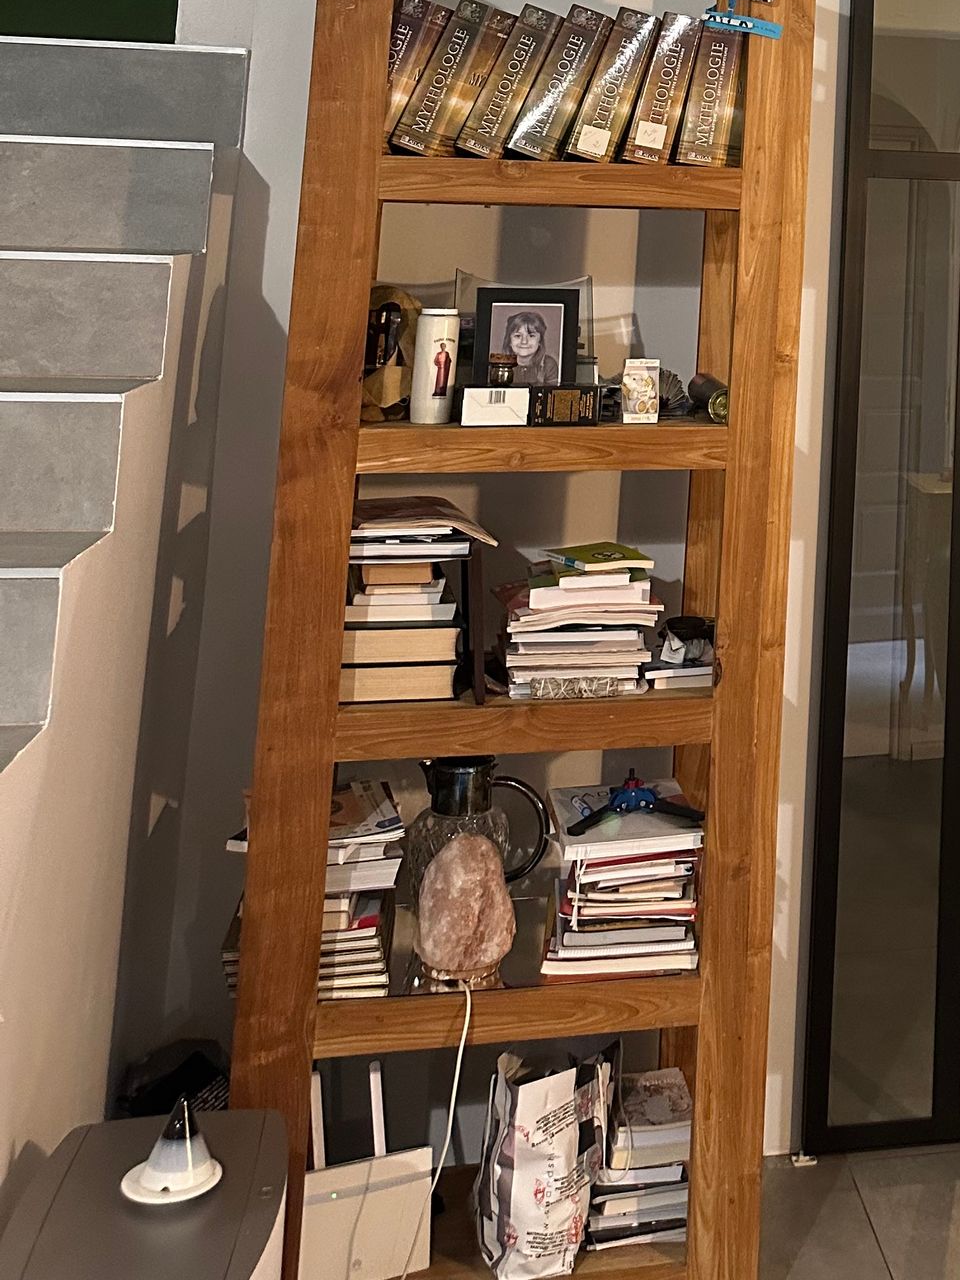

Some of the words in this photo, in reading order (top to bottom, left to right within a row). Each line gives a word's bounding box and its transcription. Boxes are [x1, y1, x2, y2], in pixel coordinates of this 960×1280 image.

[411, 27, 467, 133] MYTHOLOGIE
[477, 34, 533, 136] MYTHOLOGIE
[528, 34, 583, 137] MYOLOGIE
[592, 37, 632, 130] YTHOLOGIE
[650, 40, 682, 125] THOLOGIE
[695, 41, 724, 147] MYTHOLOGIE
